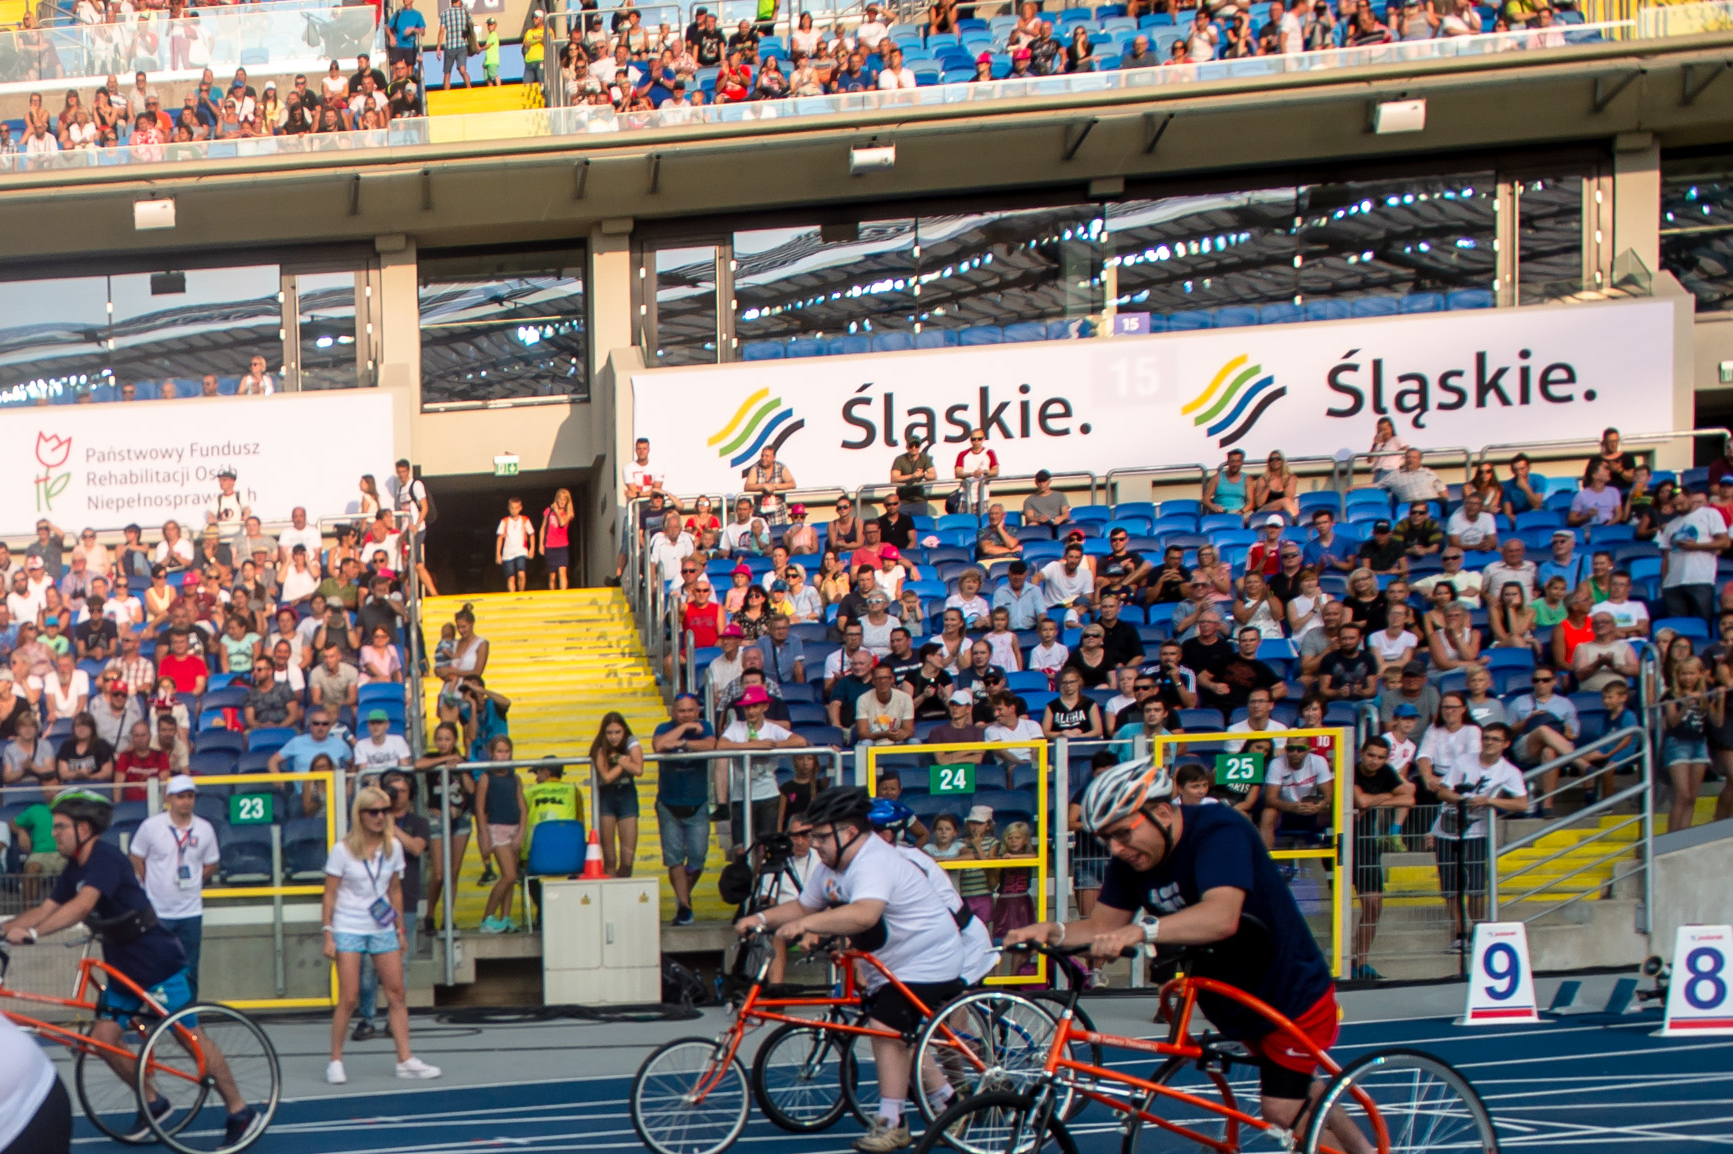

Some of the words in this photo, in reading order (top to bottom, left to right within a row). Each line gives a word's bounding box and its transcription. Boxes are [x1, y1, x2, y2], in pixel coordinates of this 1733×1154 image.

[1122, 317, 1140, 331] 15
[1111, 354, 1160, 397] 15
[1325, 348, 1598, 429] Śląskie.
[840, 382, 1093, 453] Śląskie.
[86, 446, 185, 464] Państwowy
[190, 441, 261, 458] Fundusz
[86, 467, 190, 487] Rehabilitacji
[940, 768, 967, 790] 24
[1227, 757, 1255, 779] 25
[239, 797, 264, 819] 23
[1483, 942, 1521, 1001] 9
[1684, 946, 1727, 1010] 8
